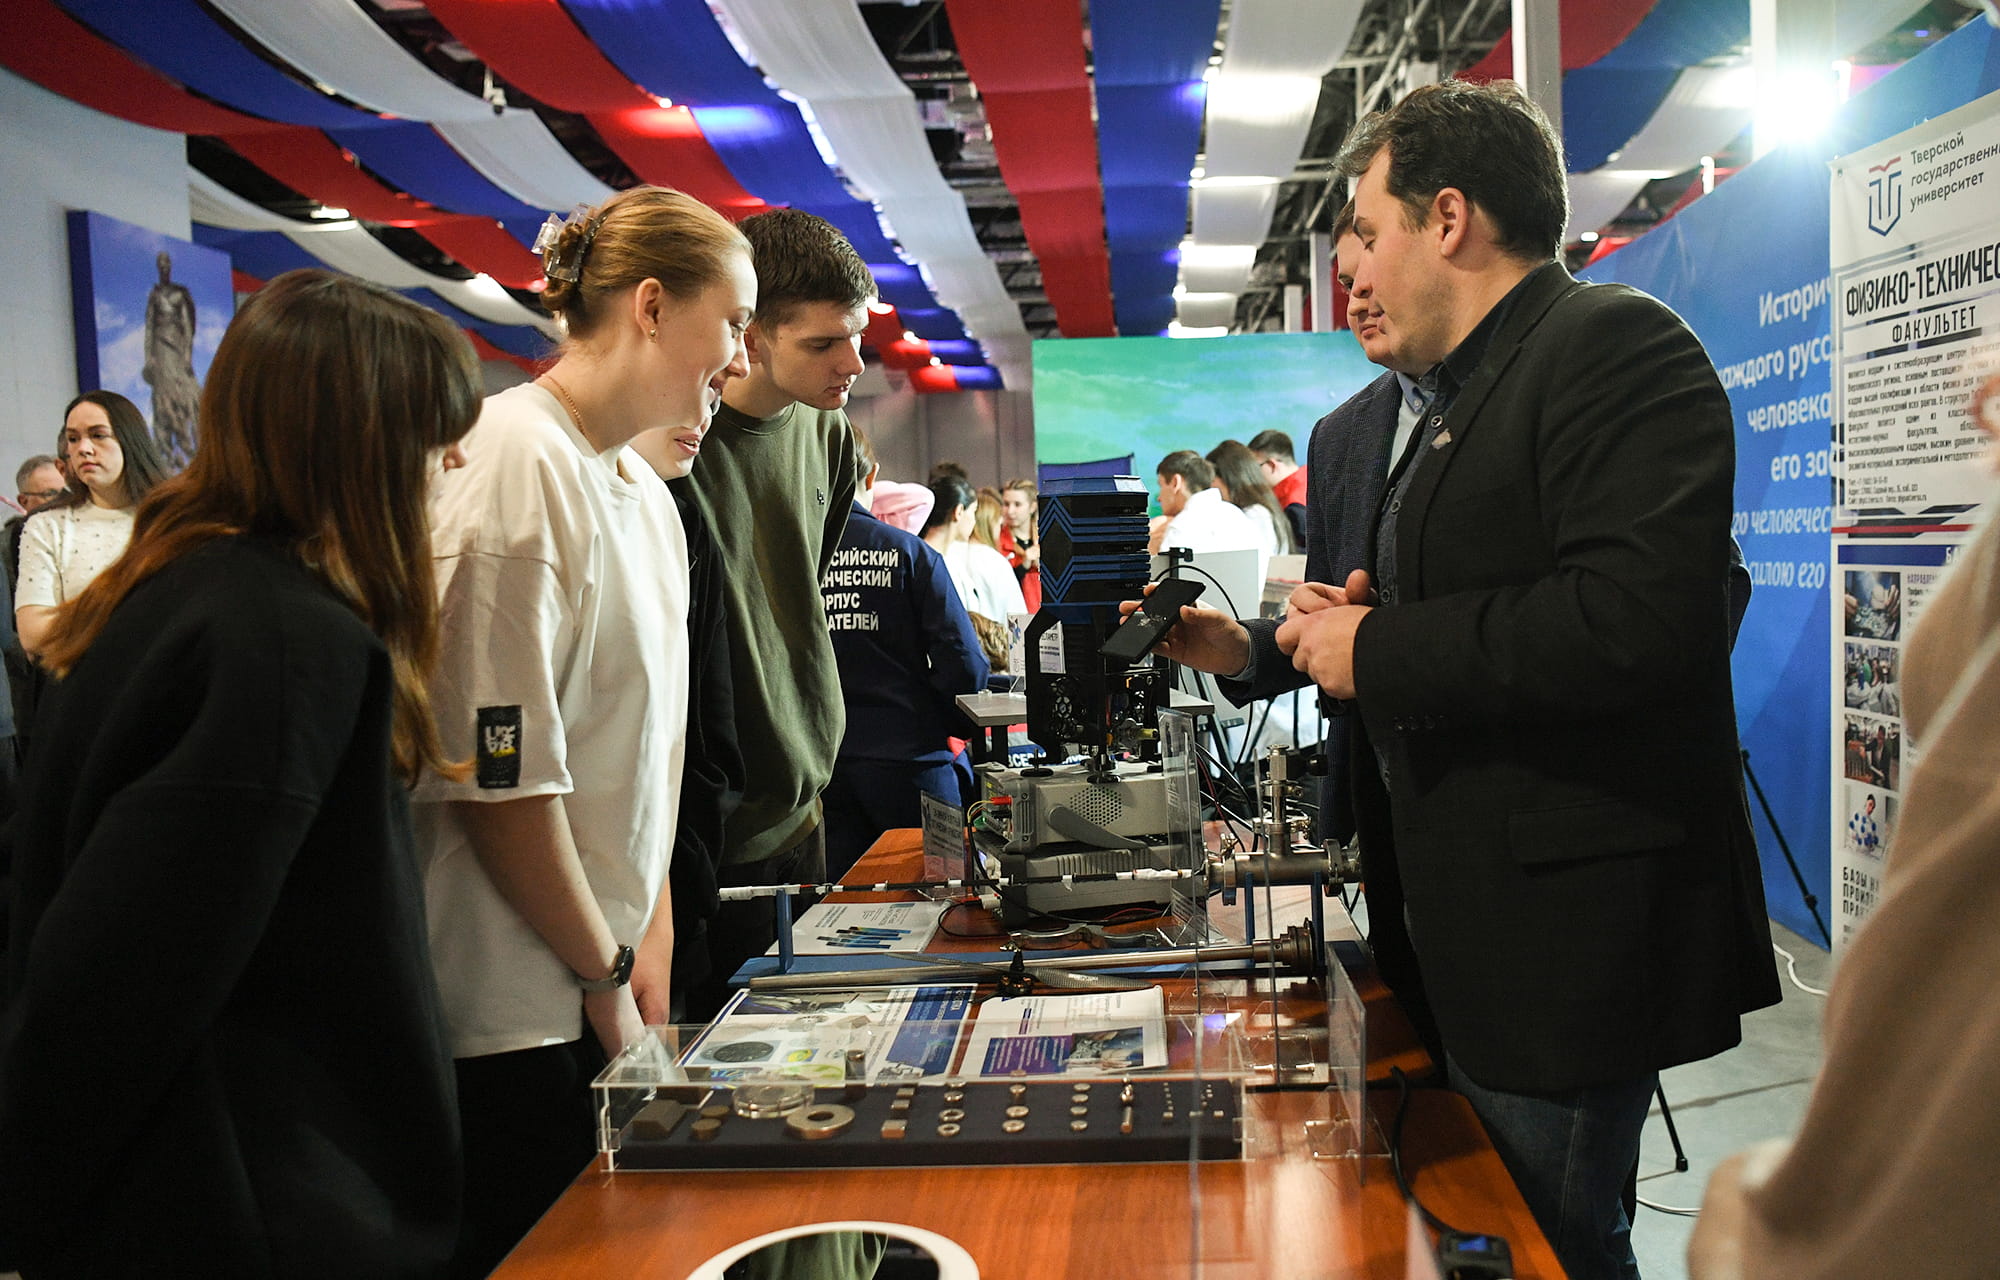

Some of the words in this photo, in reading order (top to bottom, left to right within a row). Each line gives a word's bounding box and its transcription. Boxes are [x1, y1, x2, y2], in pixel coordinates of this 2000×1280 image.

[1910, 131, 1964, 165] Тверской
[1911, 143, 2000, 186] государственн
[1910, 171, 1984, 212] университет
[1892, 306, 1976, 343] ФАКУЛЬТЕТ
[1771, 454, 1801, 482] его
[821, 568, 892, 588] НЧЕСКИЙ
[1797, 562, 1825, 589] его
[1843, 866, 1867, 888] БАЗЫ
